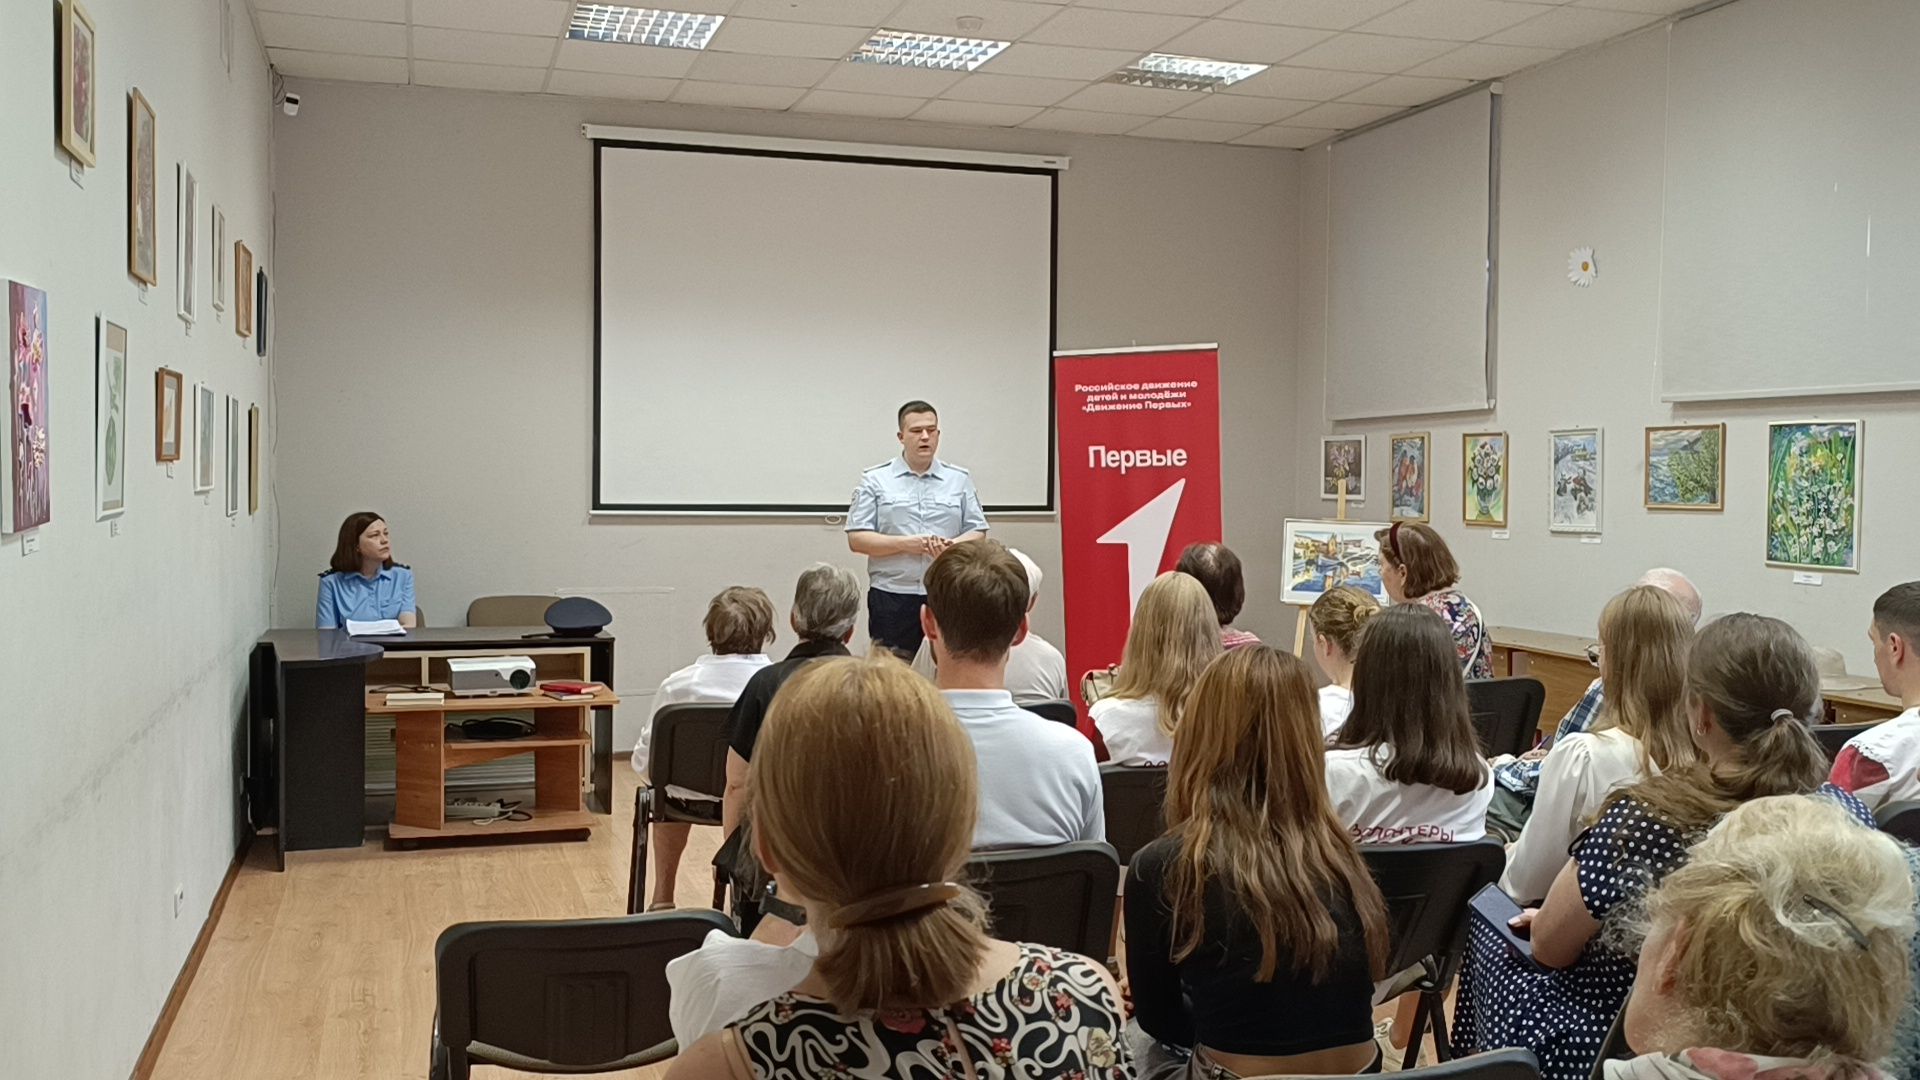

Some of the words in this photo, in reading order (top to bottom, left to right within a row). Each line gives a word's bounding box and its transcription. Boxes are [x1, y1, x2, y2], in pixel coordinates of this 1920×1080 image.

[1074, 382, 1139, 393] Российское
[1141, 380, 1198, 391] движение
[1086, 392, 1119, 402] детей
[1129, 390, 1187, 400] молодёжи
[1081, 402, 1143, 413] «Движение
[1144, 400, 1192, 411] Первых»
[1088, 445, 1188, 475] Первые
